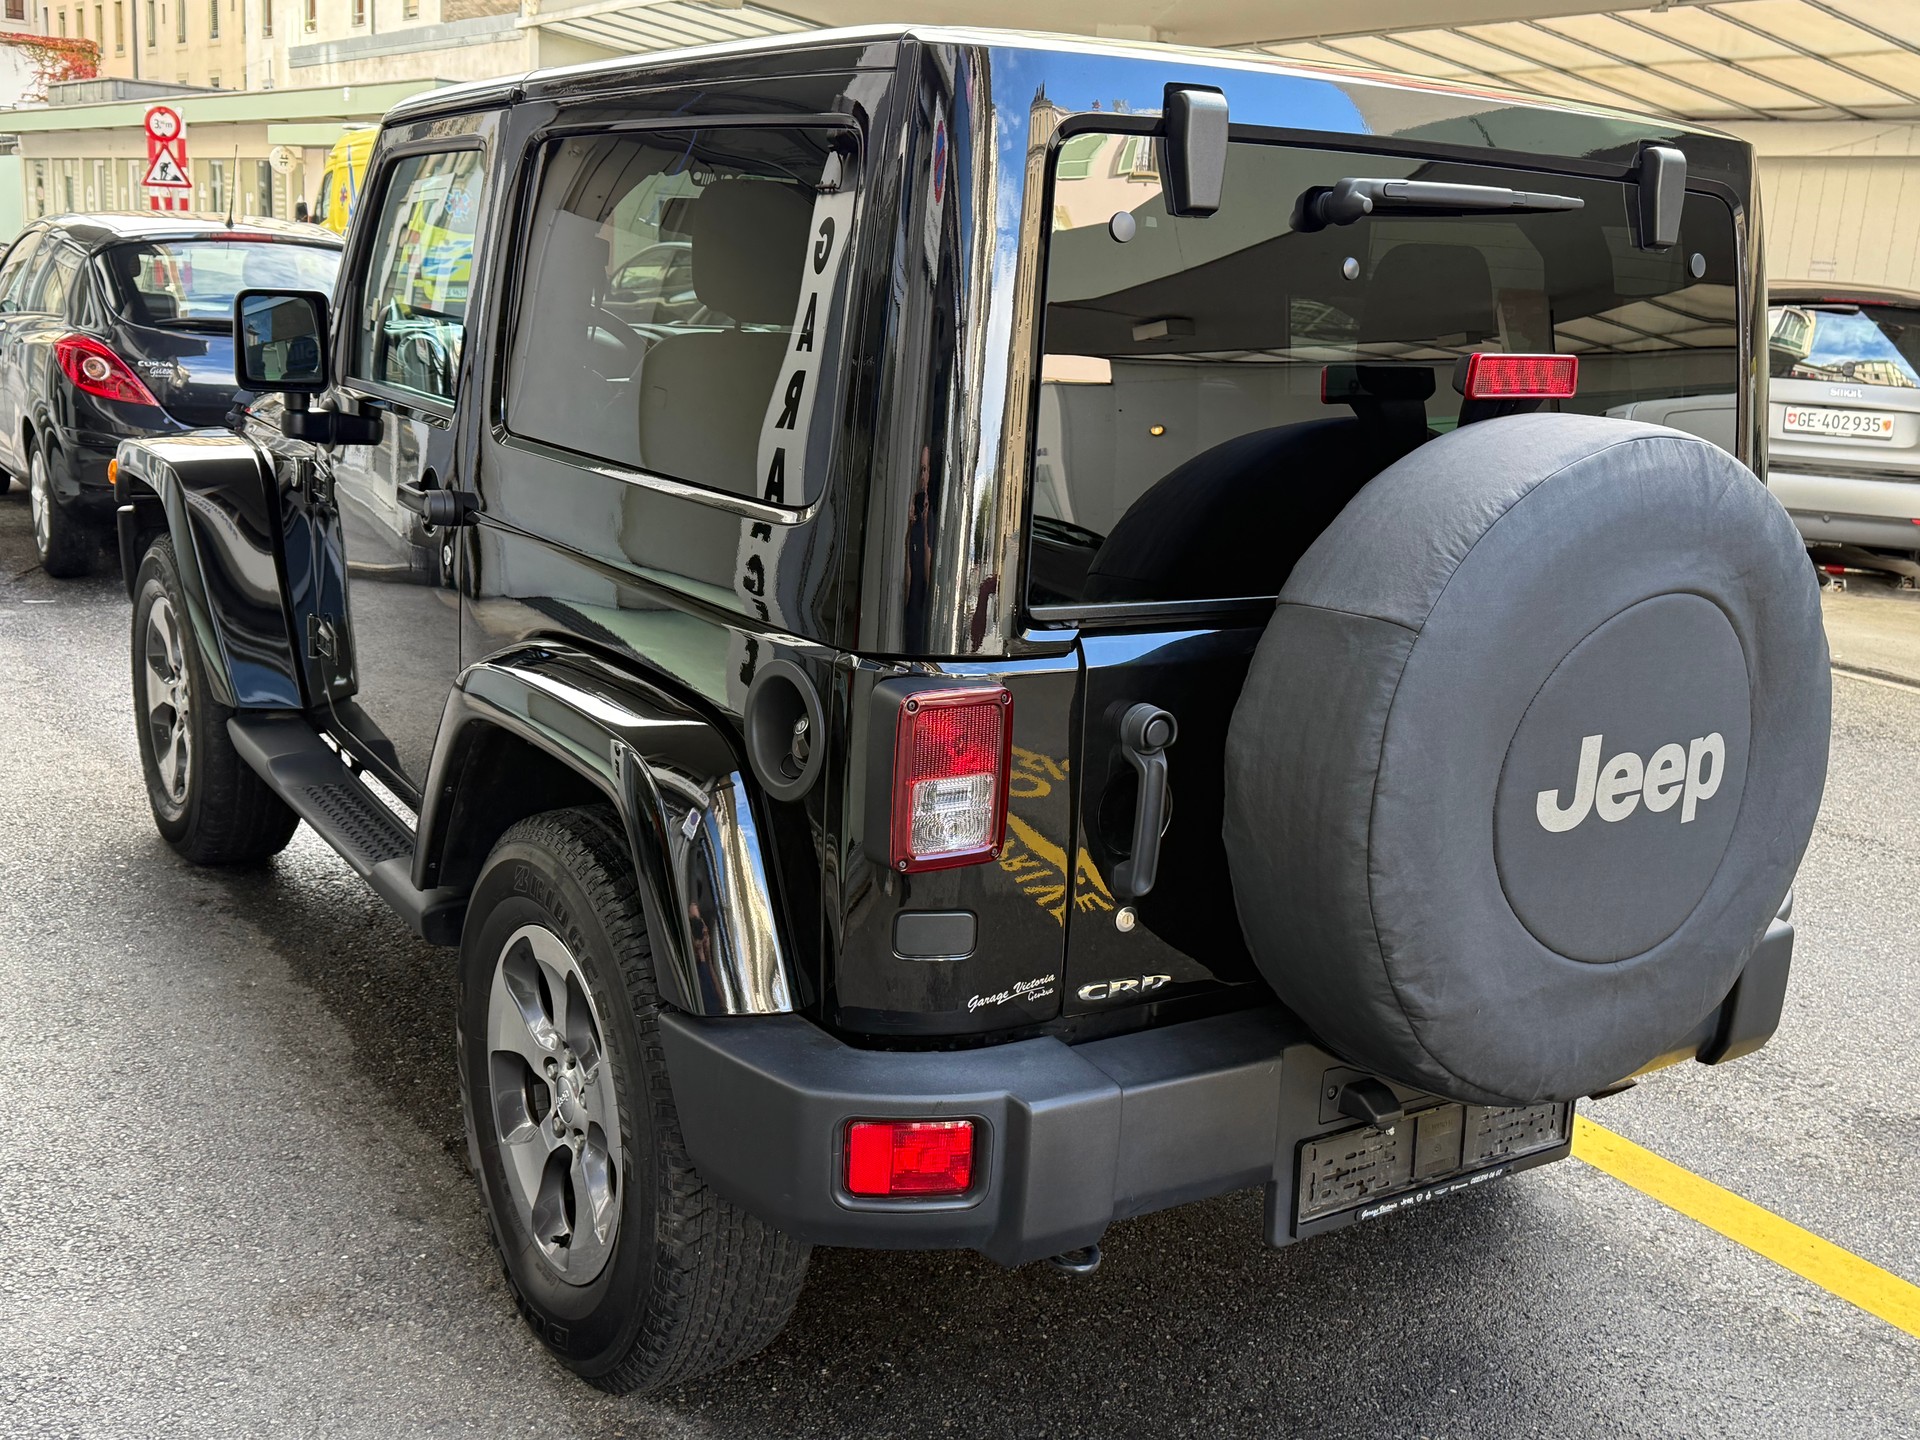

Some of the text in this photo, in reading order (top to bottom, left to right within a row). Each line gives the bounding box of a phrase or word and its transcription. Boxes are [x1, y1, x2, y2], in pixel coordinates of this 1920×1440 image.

[1829, 387, 1863, 398] smart
[1536, 731, 1726, 833] Jeep
[967, 973, 1056, 1013] Garage Victoria
[1077, 973, 1172, 1001] CRD
